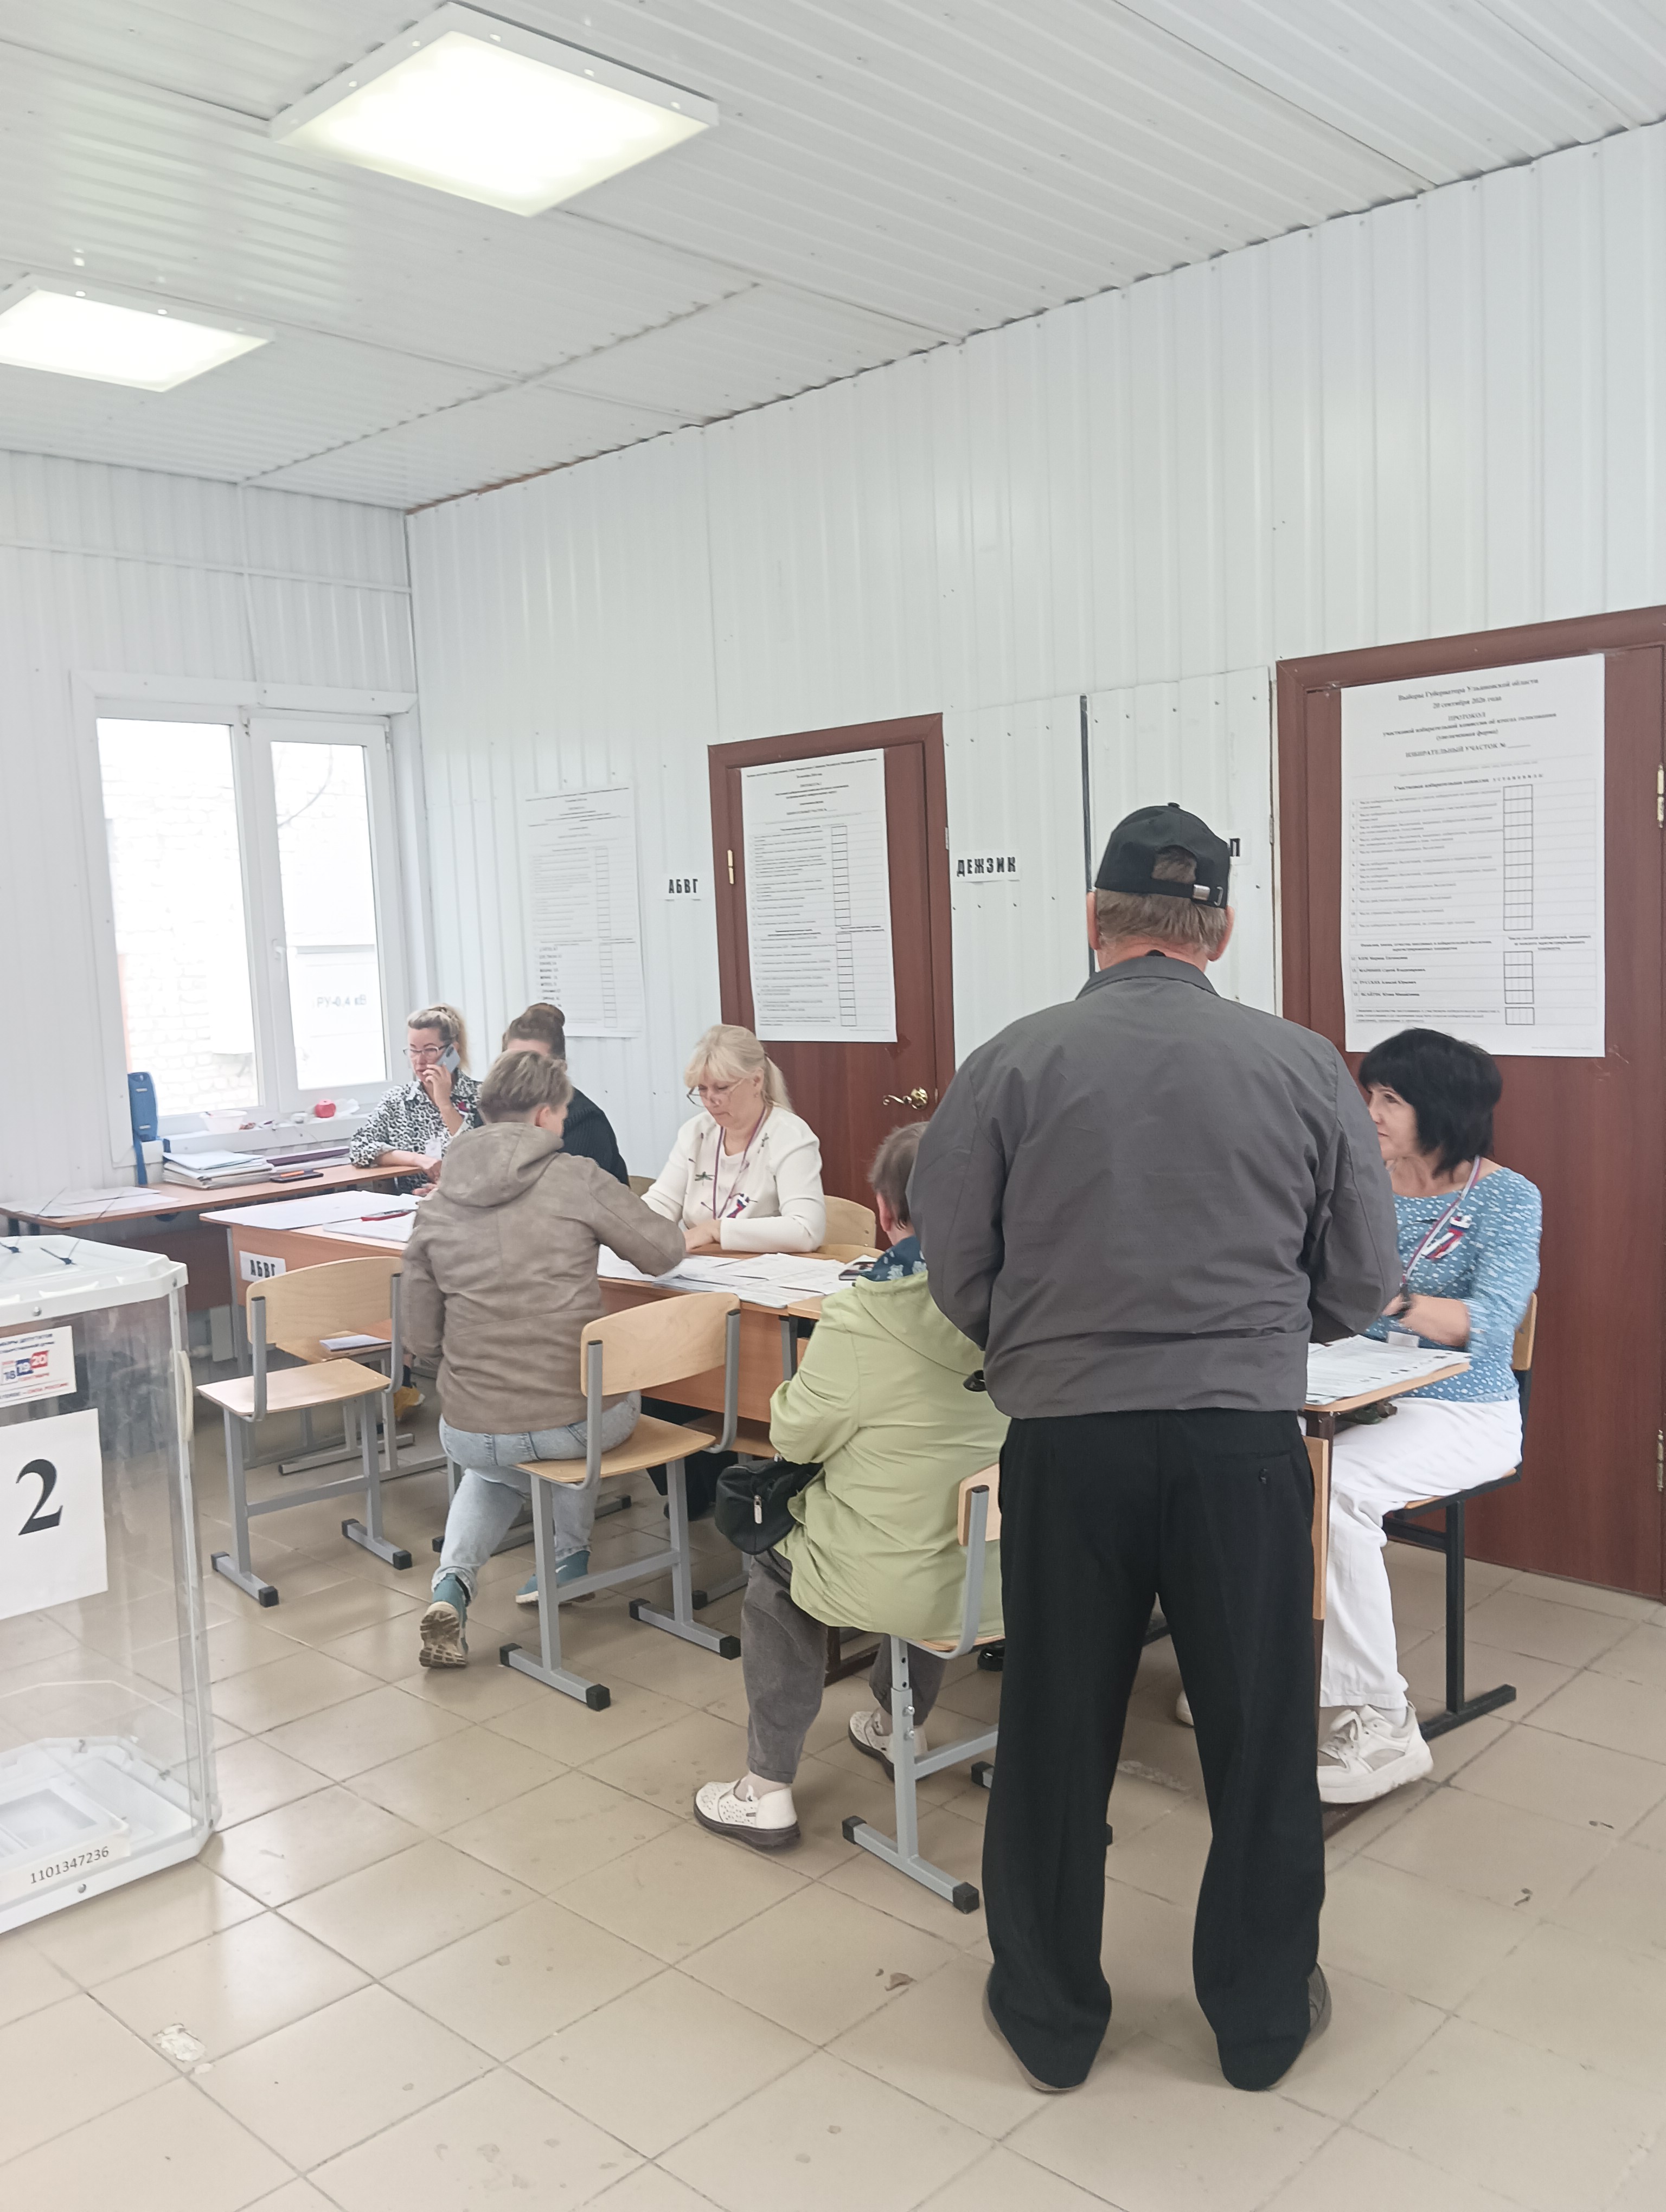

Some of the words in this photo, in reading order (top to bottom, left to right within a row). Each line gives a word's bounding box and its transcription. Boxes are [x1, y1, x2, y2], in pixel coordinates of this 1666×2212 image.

[1448, 711, 1486, 722] ПРОТОКОЛ
[956, 857, 1016, 878] ДЕЖЗИК
[668, 878, 699, 894] АБВГ
[250, 1259, 275, 1278] АБВГ
[3, 1370, 16, 1380] 18
[31, 1354, 48, 1366] 20
[16, 1458, 63, 1535] 2
[30, 1846, 110, 1884] 1101347236
